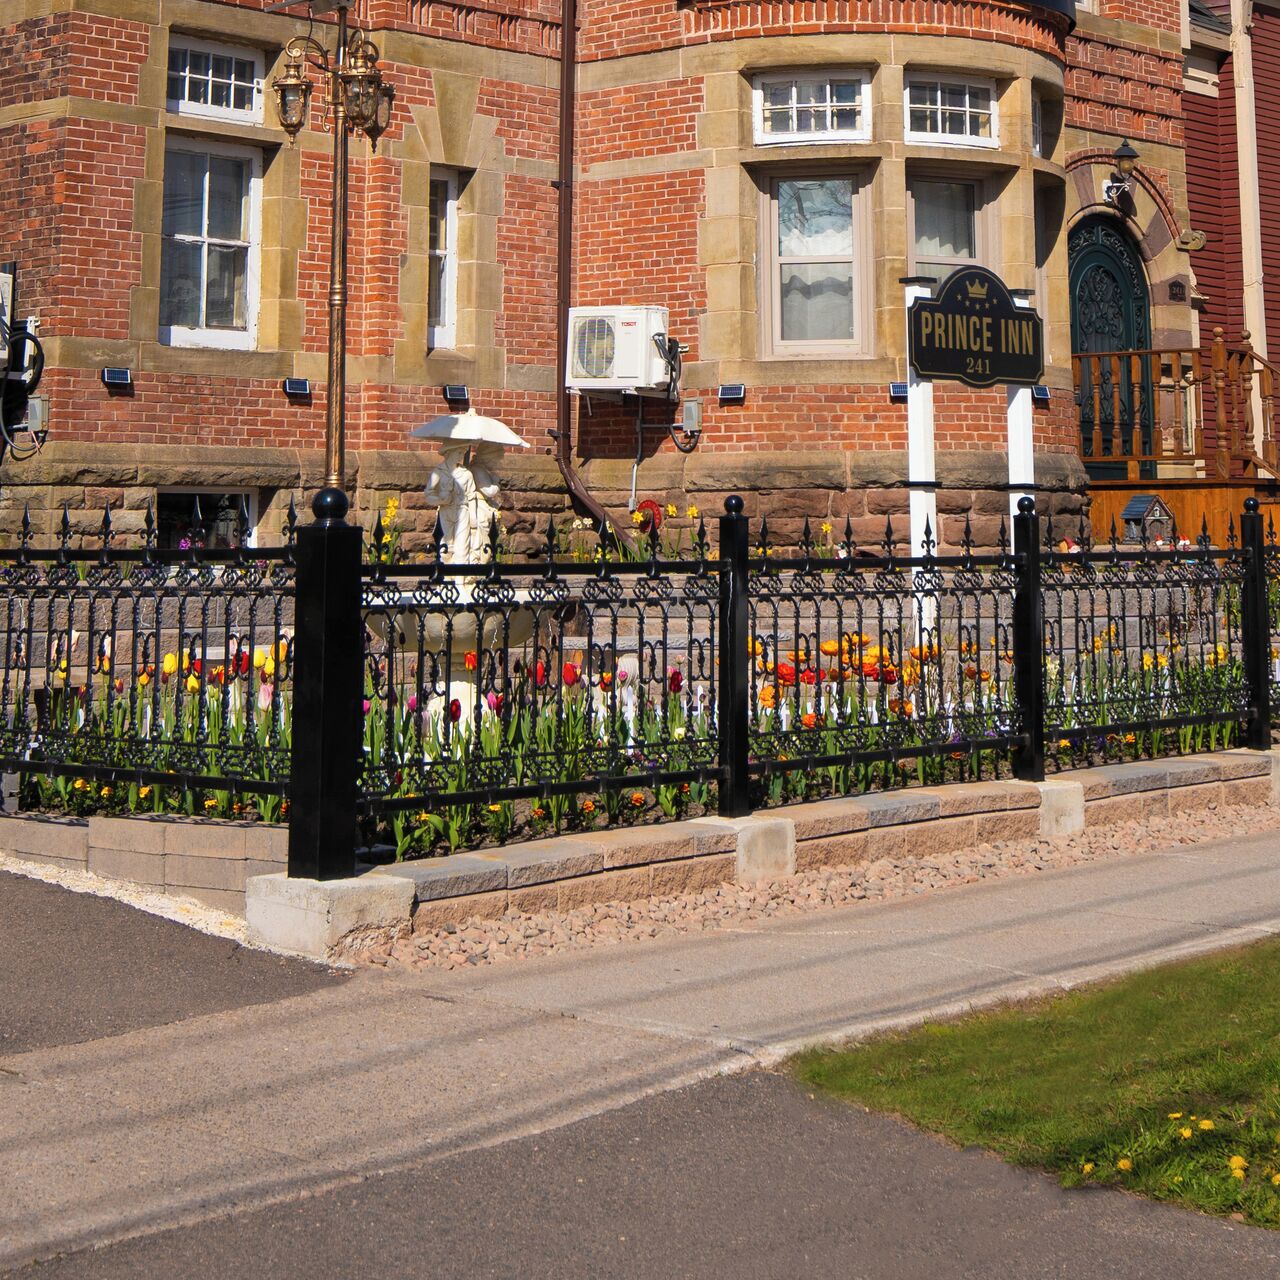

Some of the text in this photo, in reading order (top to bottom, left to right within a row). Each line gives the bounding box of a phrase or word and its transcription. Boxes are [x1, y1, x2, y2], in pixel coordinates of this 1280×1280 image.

[921, 311, 1034, 355] PRINCE INN
[966, 357, 991, 374] 241
